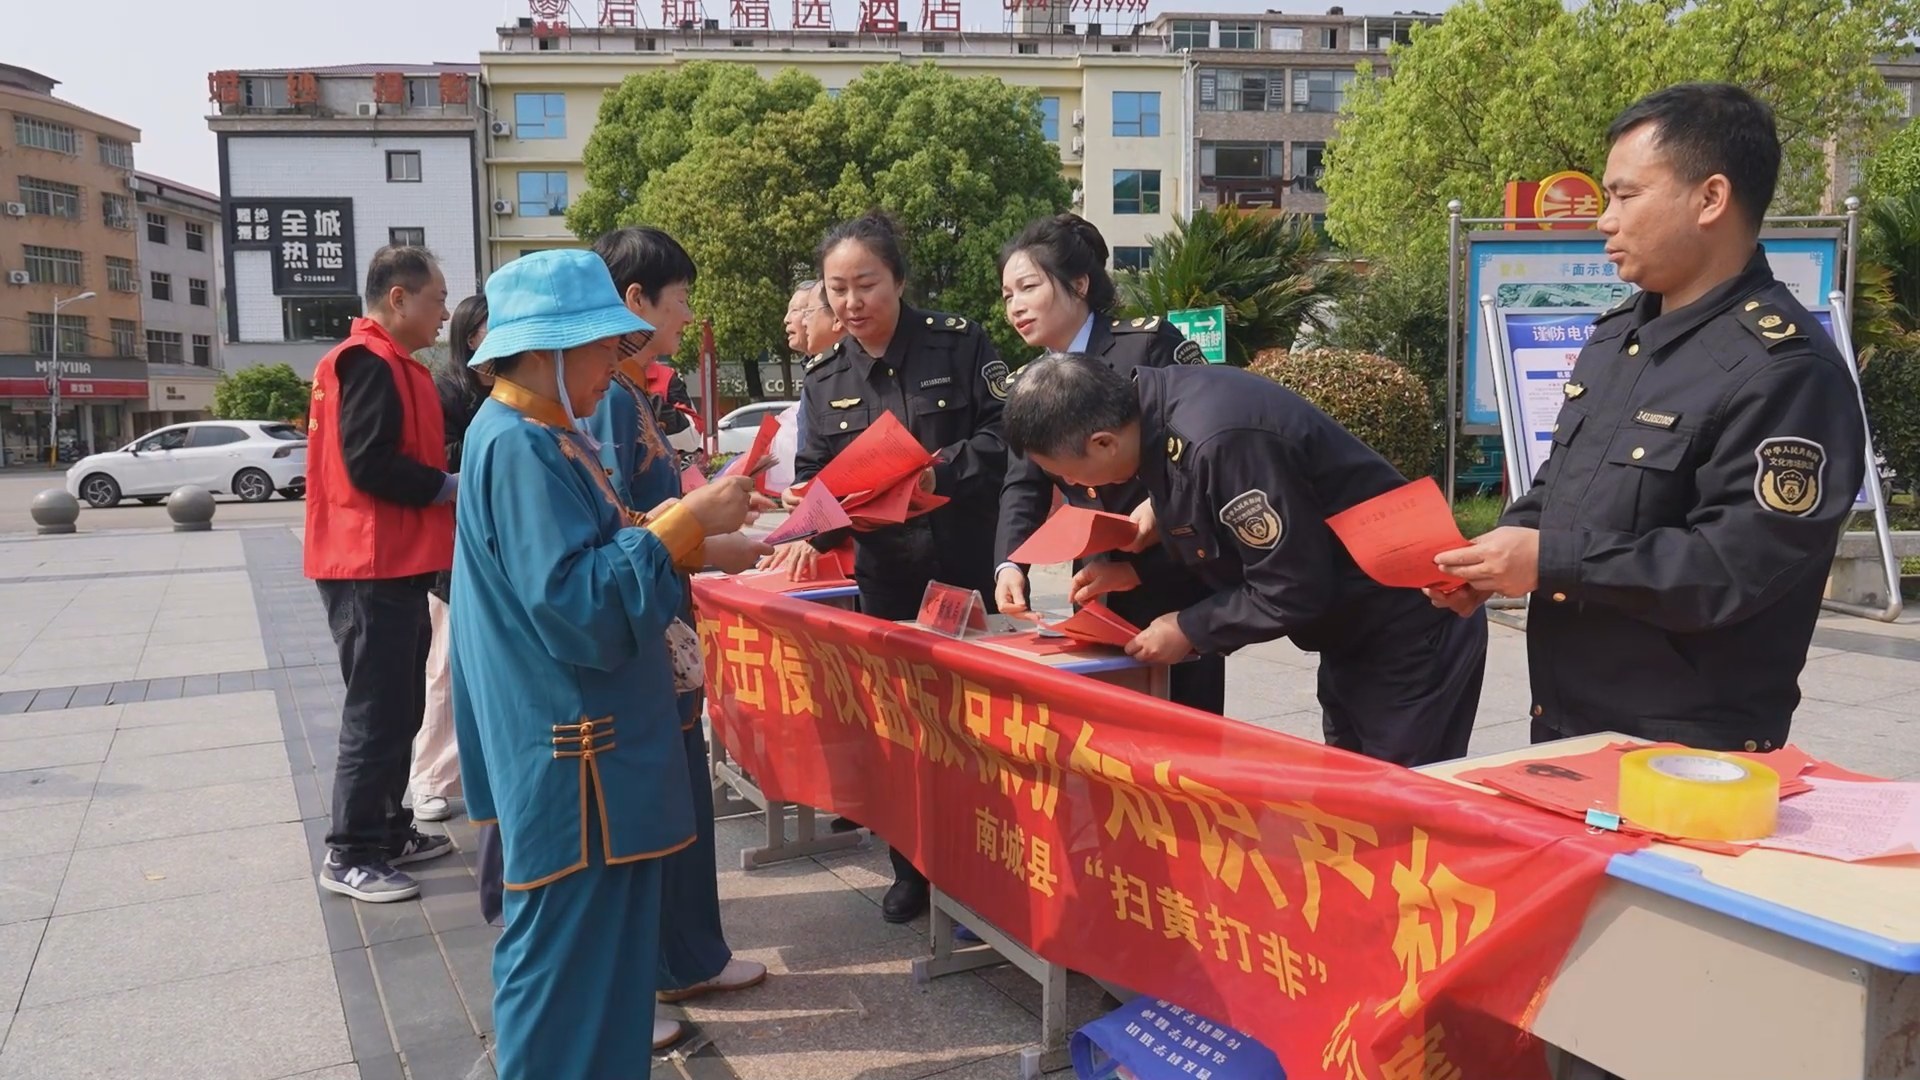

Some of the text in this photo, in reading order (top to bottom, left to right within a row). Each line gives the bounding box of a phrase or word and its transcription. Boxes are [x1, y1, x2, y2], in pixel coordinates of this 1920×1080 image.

[281, 209, 341, 237] 全城
[282, 241, 343, 269] 热恋
[344, 867, 368, 887] N
